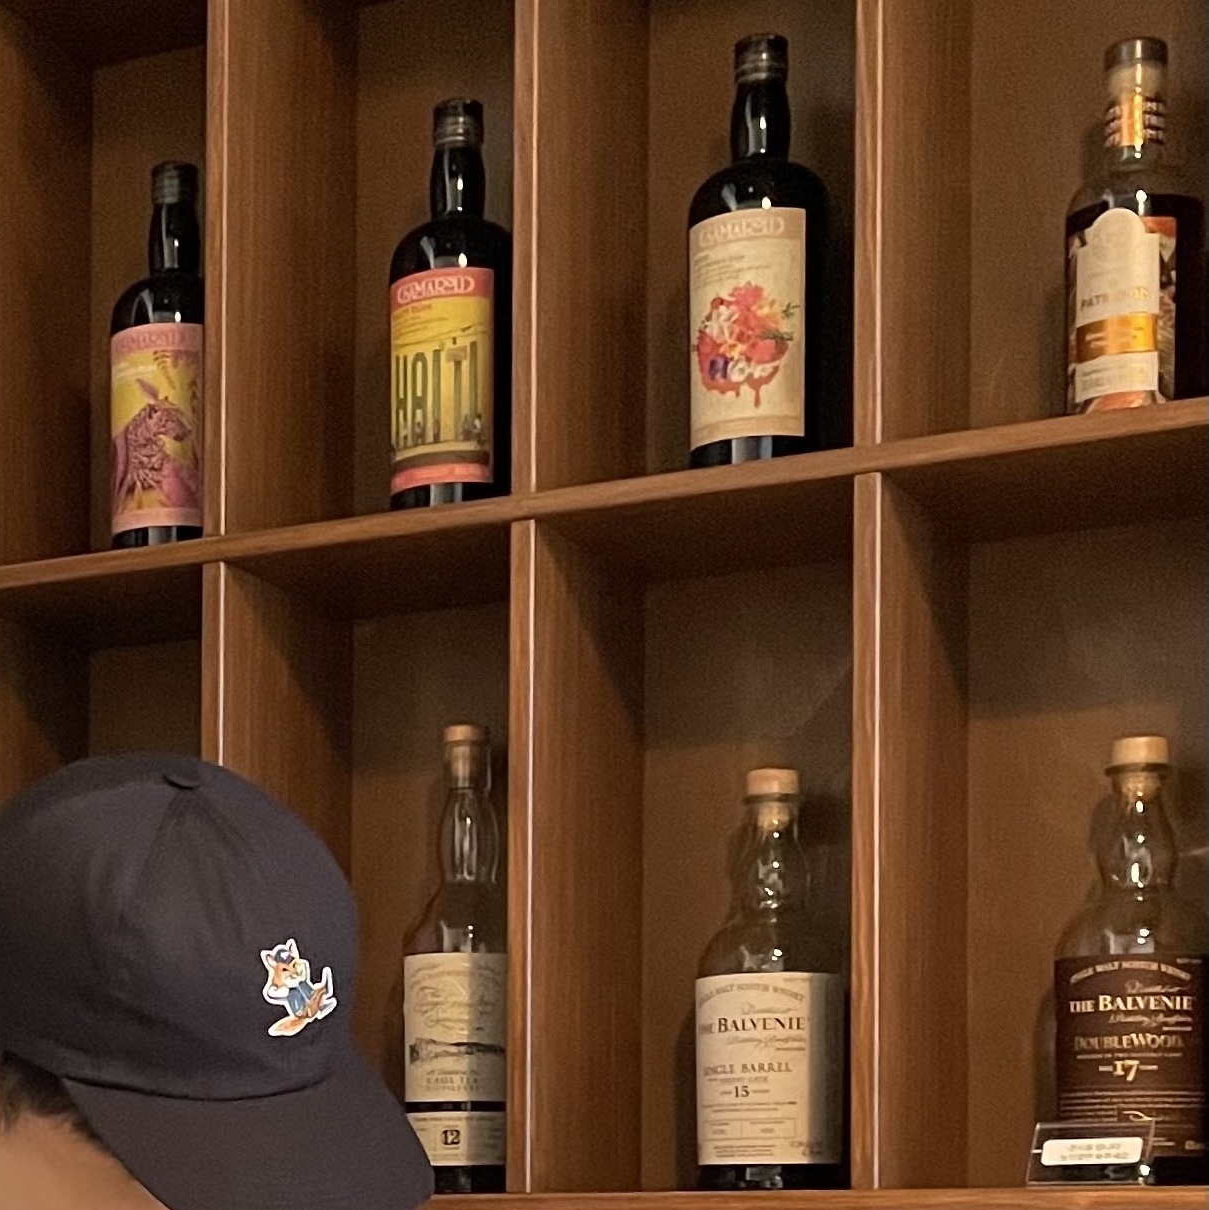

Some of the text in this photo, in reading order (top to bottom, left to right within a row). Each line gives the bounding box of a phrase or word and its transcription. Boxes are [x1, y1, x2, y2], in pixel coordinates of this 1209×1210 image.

[395, 340, 479, 449] HAITI
[1070, 994, 1192, 1013] THE BALVENIE
[717, 1017, 806, 1033] BALVENIE
[740, 1062, 793, 1073] BARREL
[1113, 1060, 1140, 1082] 17
[734, 1085, 750, 1098] 15
[441, 1129, 461, 1146] 12
